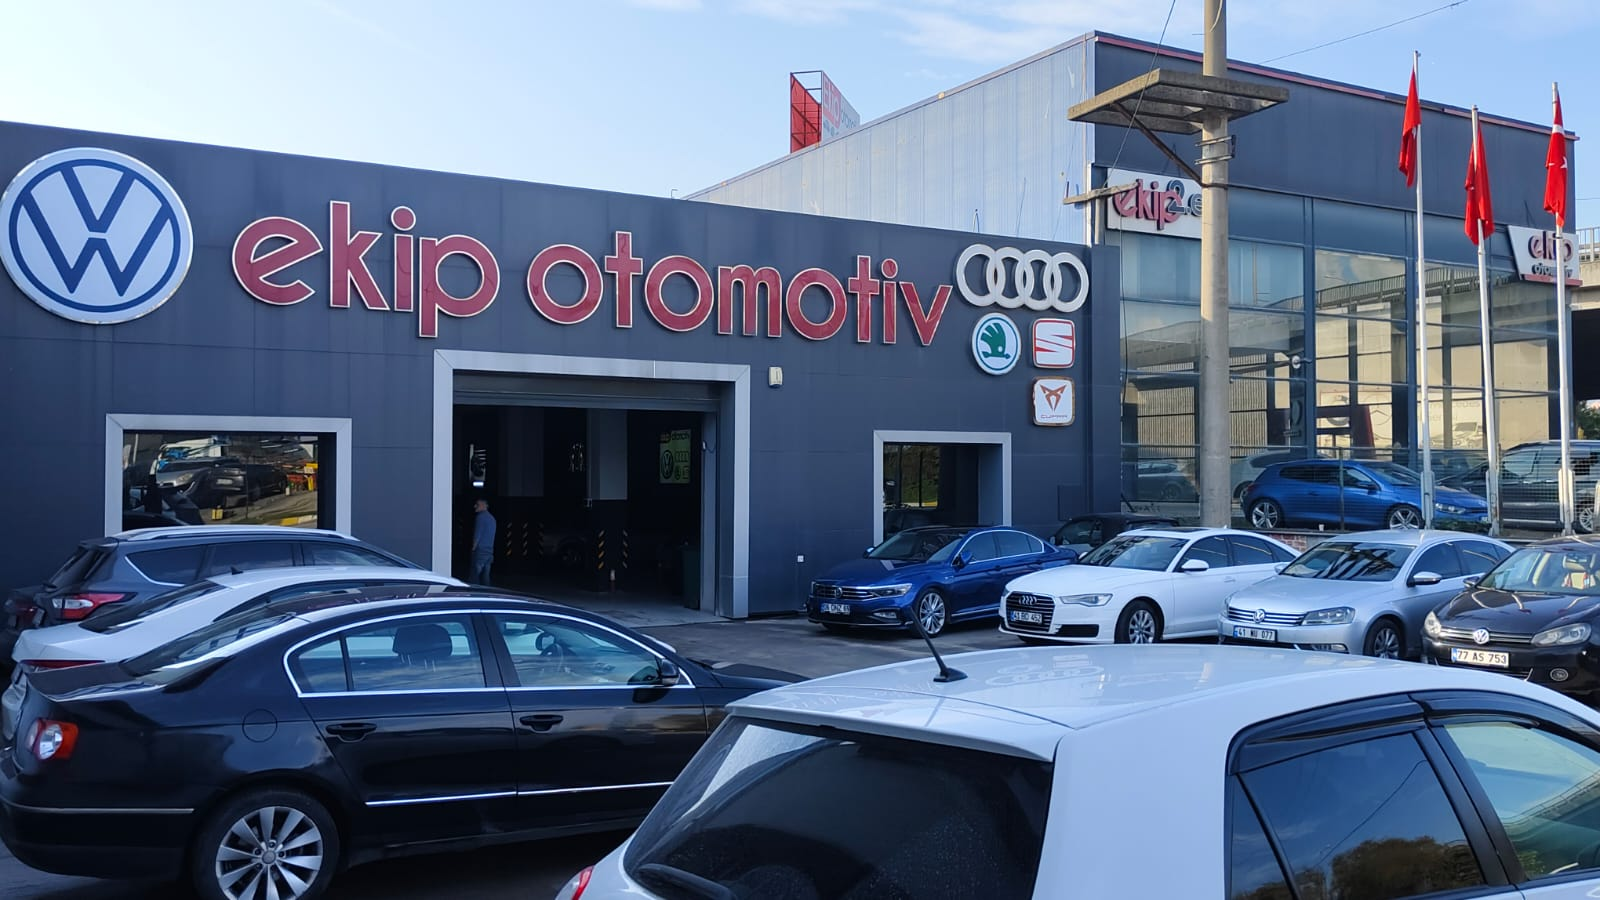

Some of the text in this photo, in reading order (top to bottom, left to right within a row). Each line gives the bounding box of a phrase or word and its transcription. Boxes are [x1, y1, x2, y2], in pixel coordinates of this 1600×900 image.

[1112, 178, 1182, 231] ekip
[232, 200, 953, 346] ekip otomotiv
[1238, 628, 1246, 636] 41
[1261, 630, 1273, 639] 077
[1457, 650, 1507, 664] 77 AS 753
